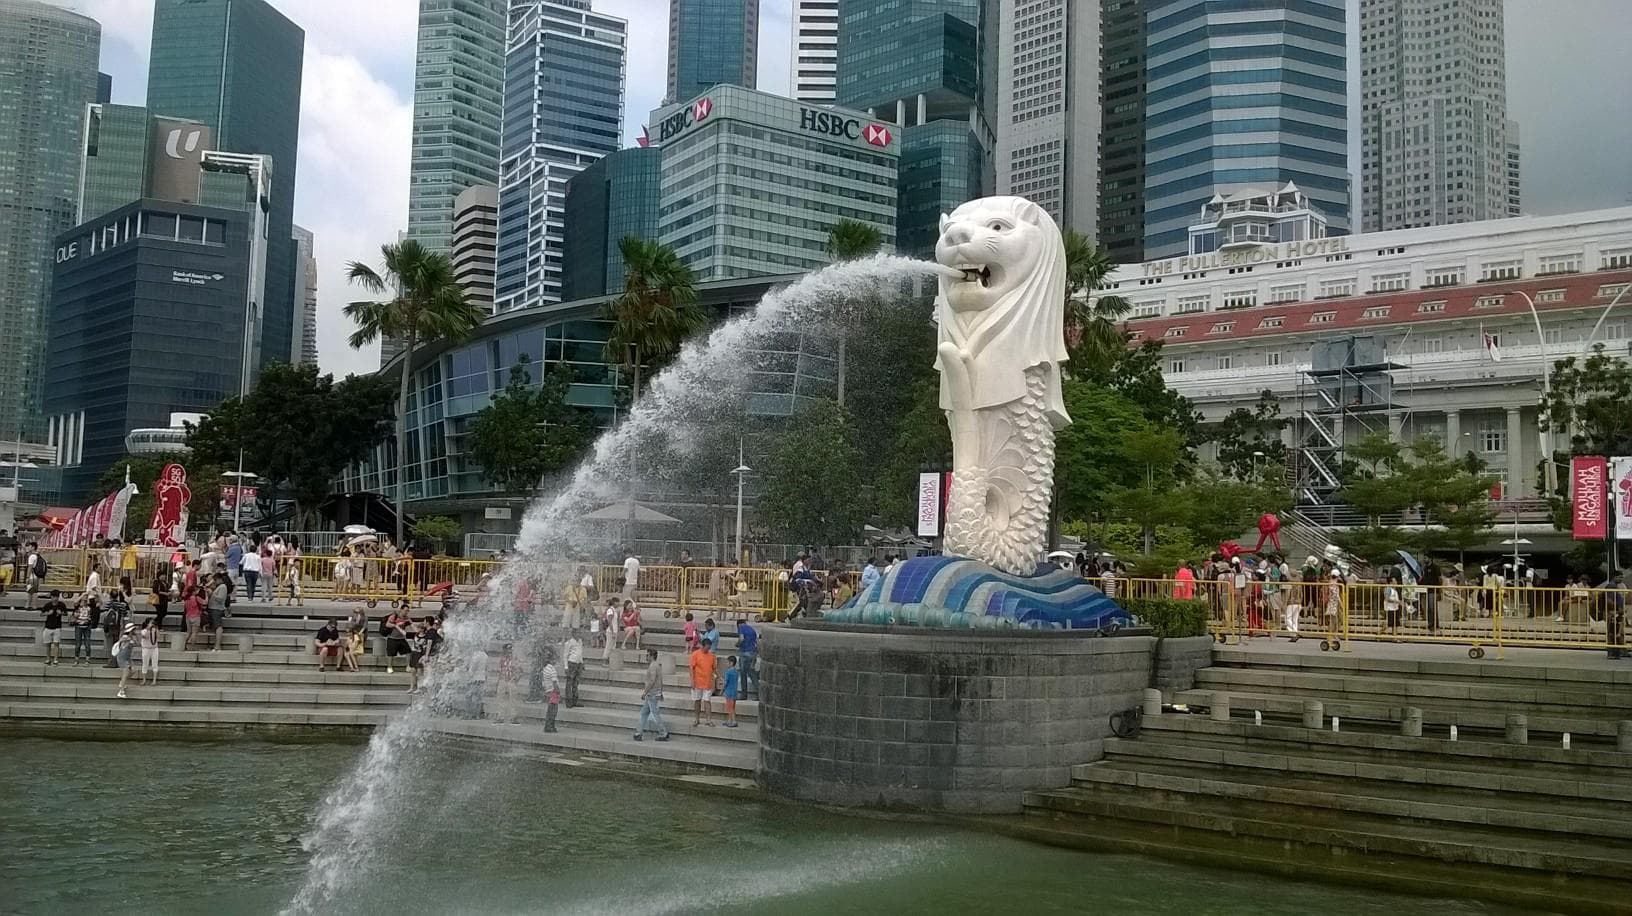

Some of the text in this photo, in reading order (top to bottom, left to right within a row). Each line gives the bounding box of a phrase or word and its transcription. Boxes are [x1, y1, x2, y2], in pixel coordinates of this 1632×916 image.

[660, 105, 693, 142] HSBC
[800, 107, 860, 140] HSBC
[1141, 237, 1350, 276] THE FULLERTON HOTEL
[1578, 469, 1587, 521] MAJULAH
[1586, 465, 1598, 527] SINGAPURA
